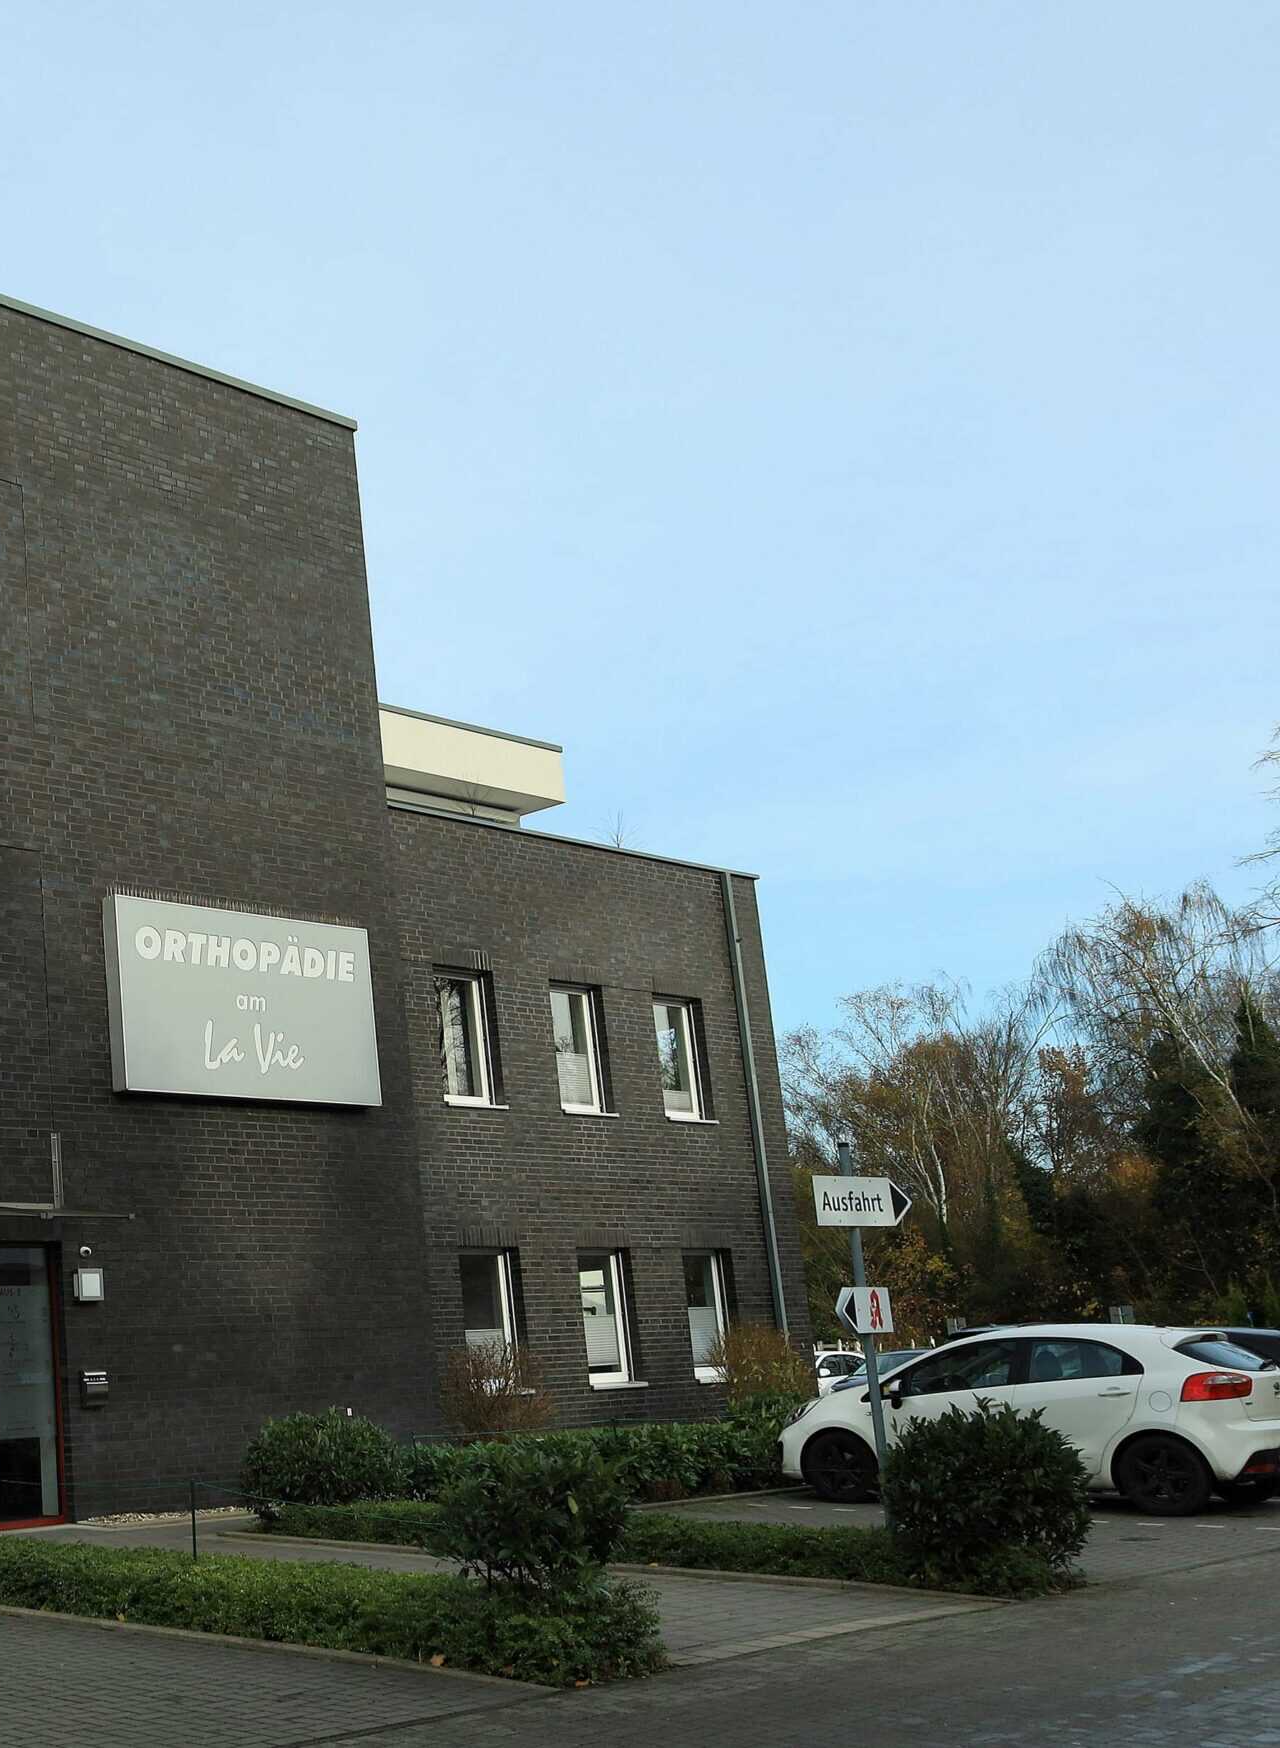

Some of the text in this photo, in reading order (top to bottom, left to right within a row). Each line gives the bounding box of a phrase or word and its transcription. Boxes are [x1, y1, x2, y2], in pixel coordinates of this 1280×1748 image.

[135, 925, 355, 982] ORTHOPÄDIE
[236, 993, 266, 1012] am
[204, 1019, 305, 1074] La Vie
[822, 1191, 884, 1212] Ausfahrt
